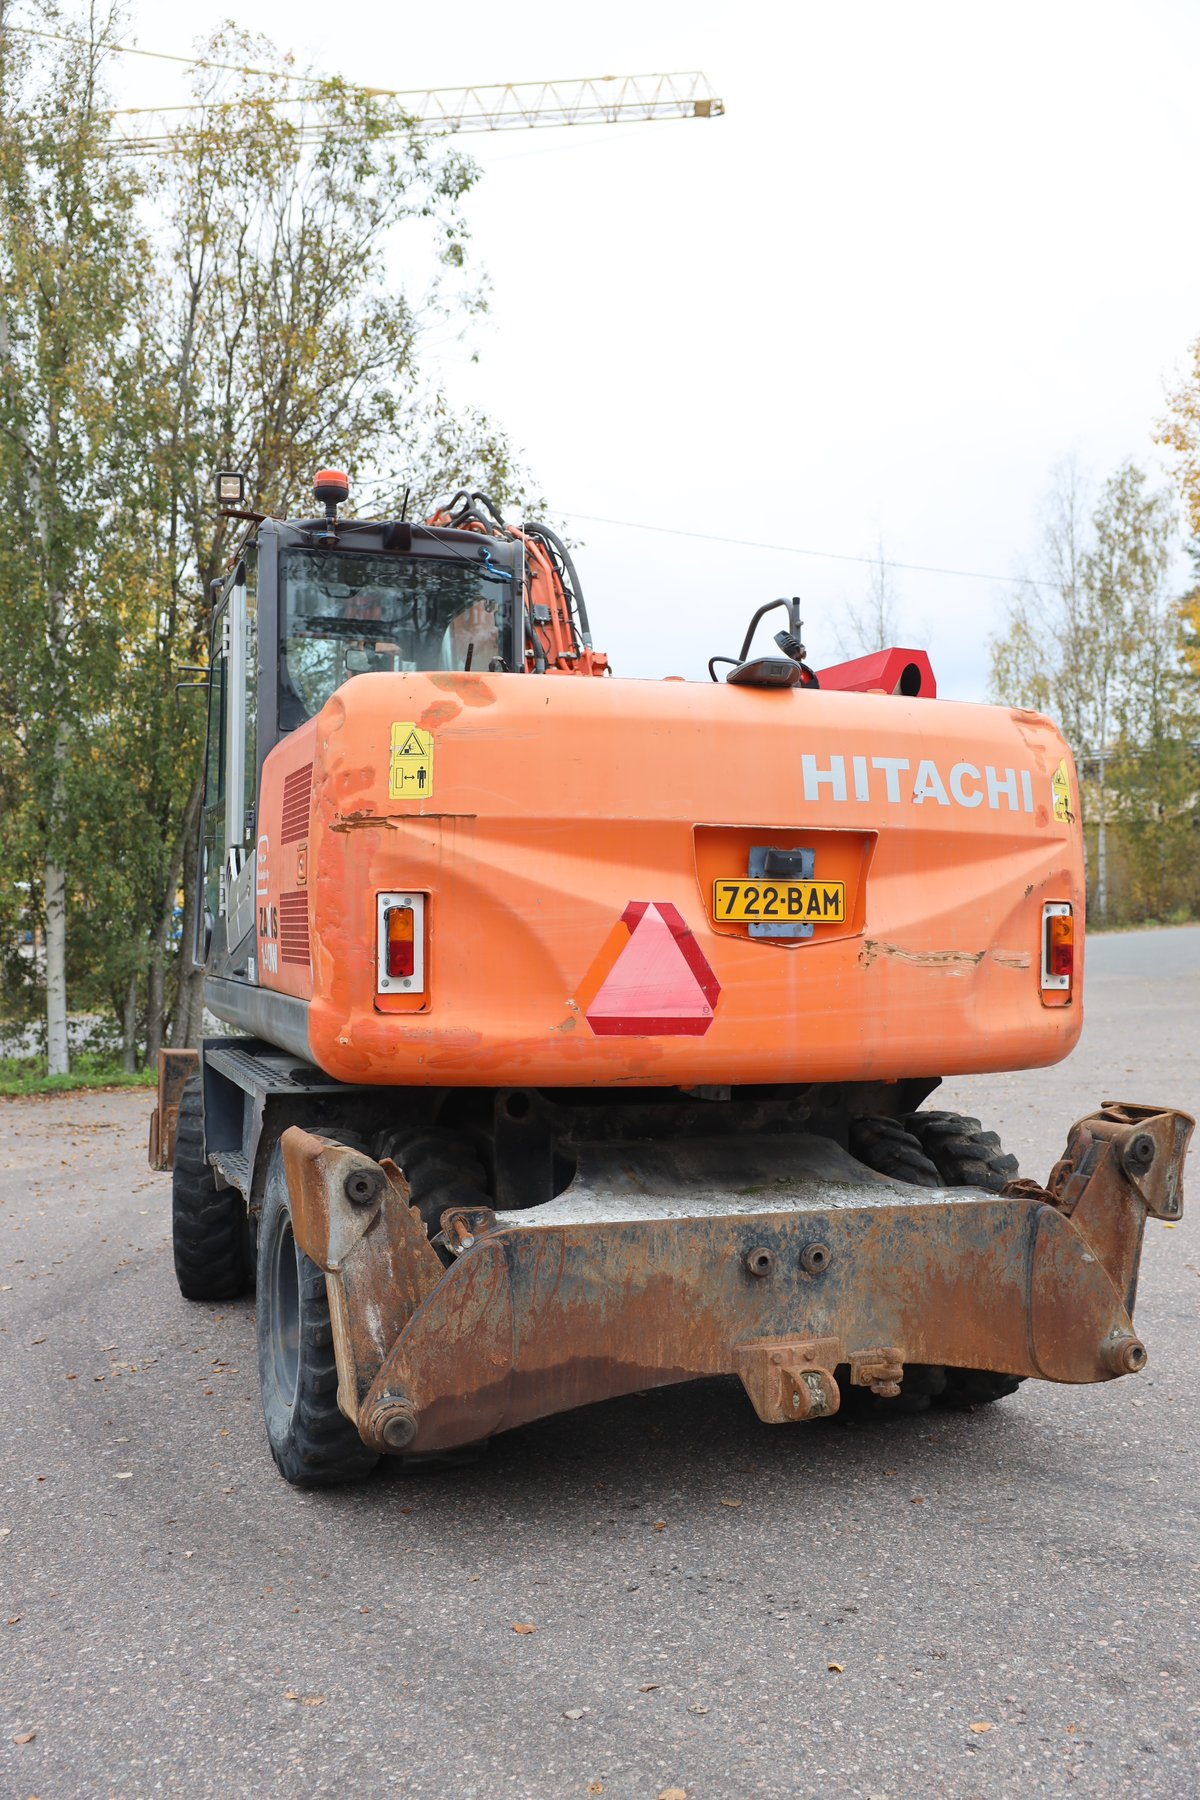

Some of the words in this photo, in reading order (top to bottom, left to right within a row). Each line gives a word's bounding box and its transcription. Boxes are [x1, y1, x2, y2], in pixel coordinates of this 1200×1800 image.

[801, 754, 1034, 813] HITACHI
[723, 886, 839, 915] 722-BAM
[259, 903, 278, 939] ZAXIS
